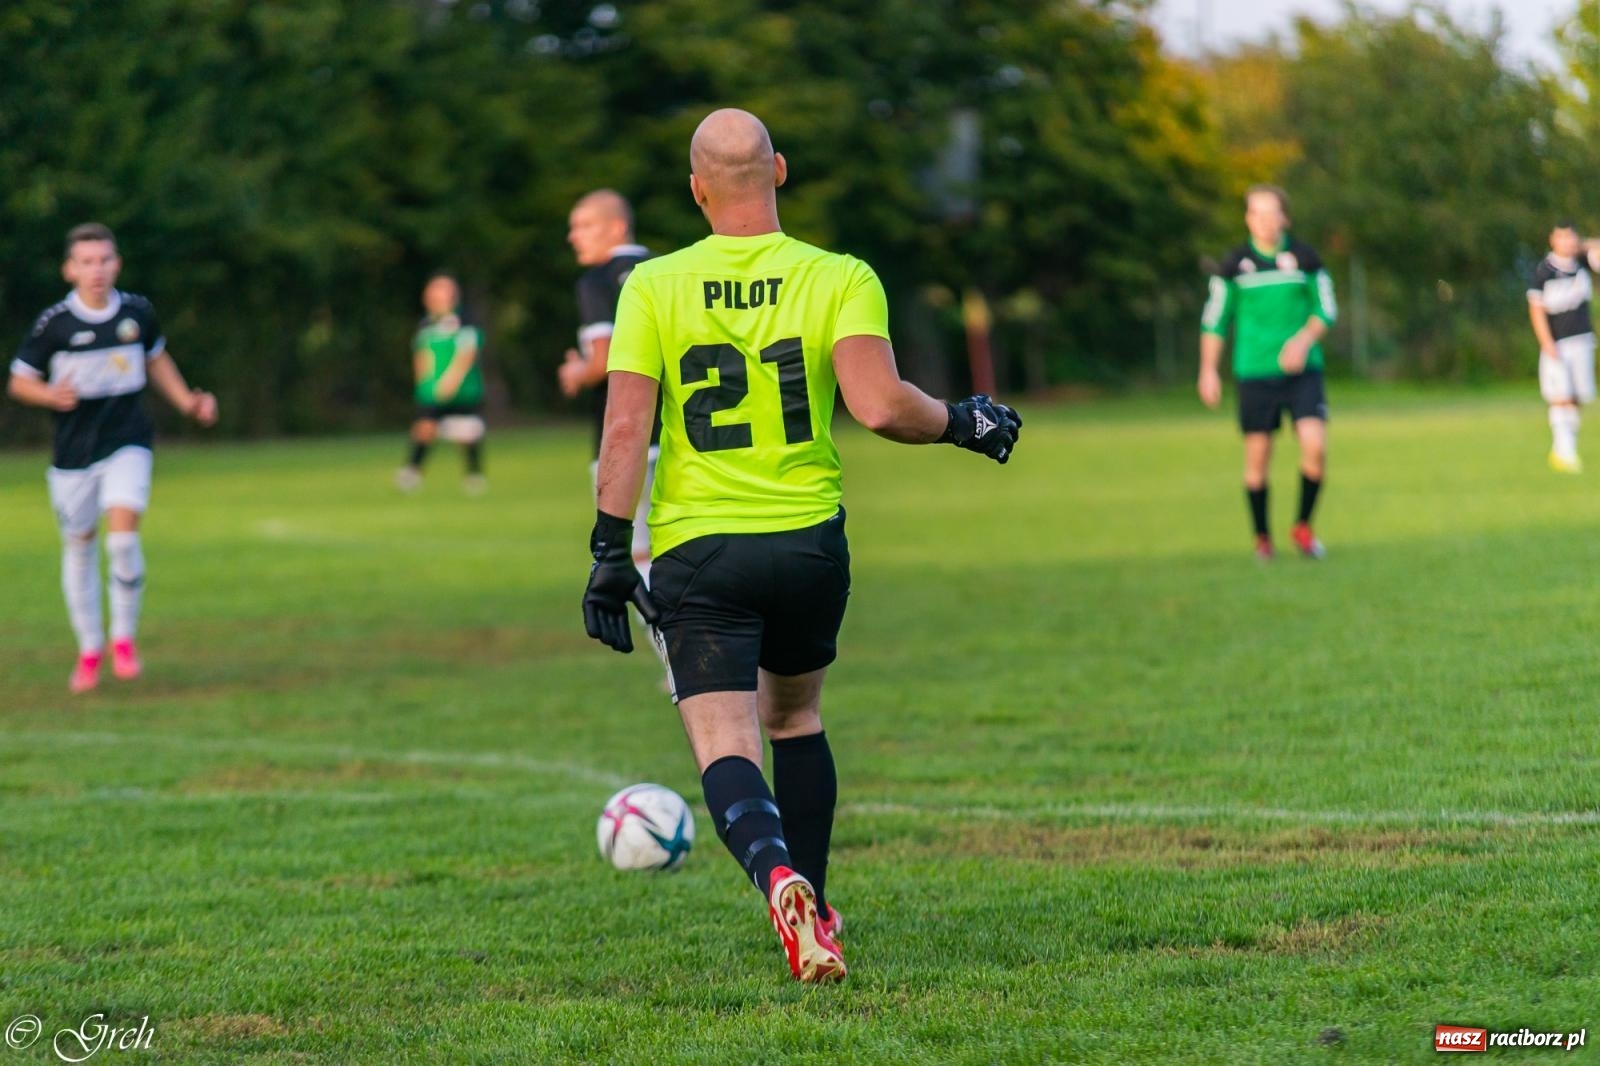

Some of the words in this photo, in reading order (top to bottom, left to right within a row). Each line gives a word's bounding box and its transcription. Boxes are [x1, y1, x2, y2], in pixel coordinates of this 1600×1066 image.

[703, 278, 783, 310] PILOT
[680, 336, 814, 453] 21
[972, 409, 984, 440] SELECT
